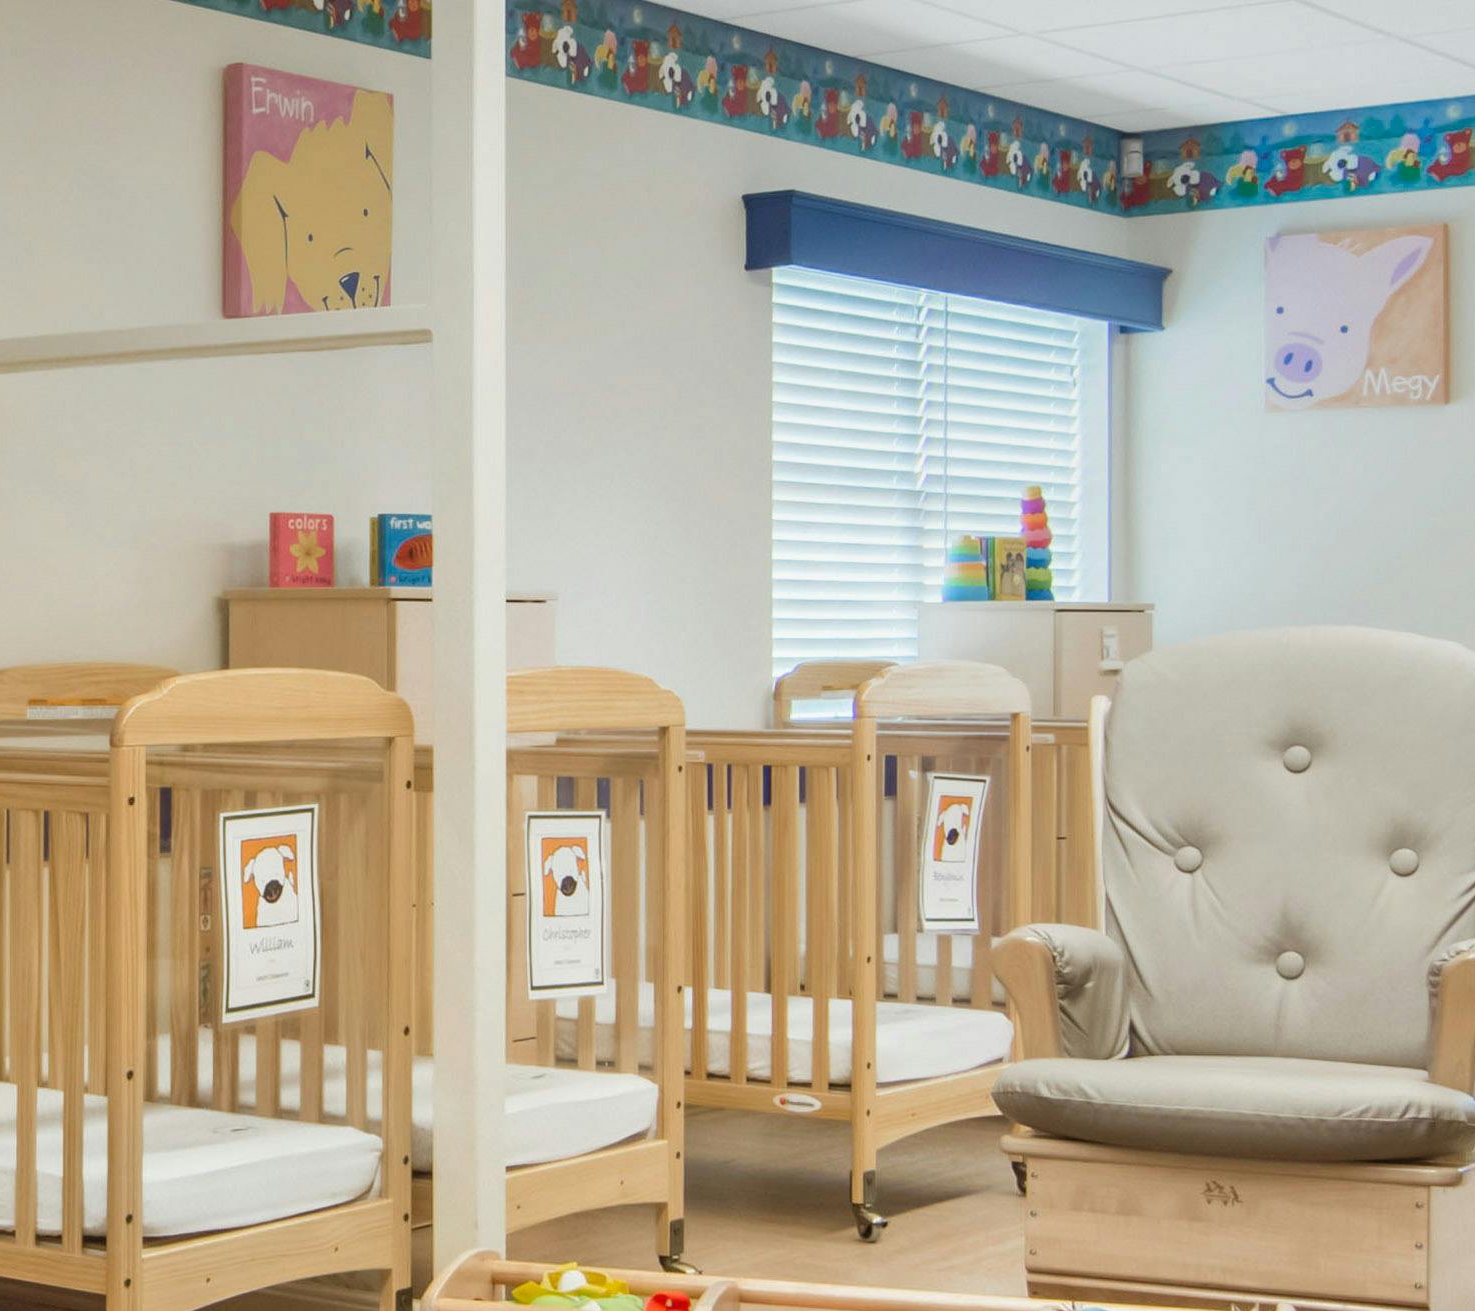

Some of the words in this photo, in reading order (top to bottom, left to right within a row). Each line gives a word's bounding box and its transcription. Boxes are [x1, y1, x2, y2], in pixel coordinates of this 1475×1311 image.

[250, 76, 315, 123] Erwin
[288, 515, 328, 530] colors
[389, 517, 413, 530] first
